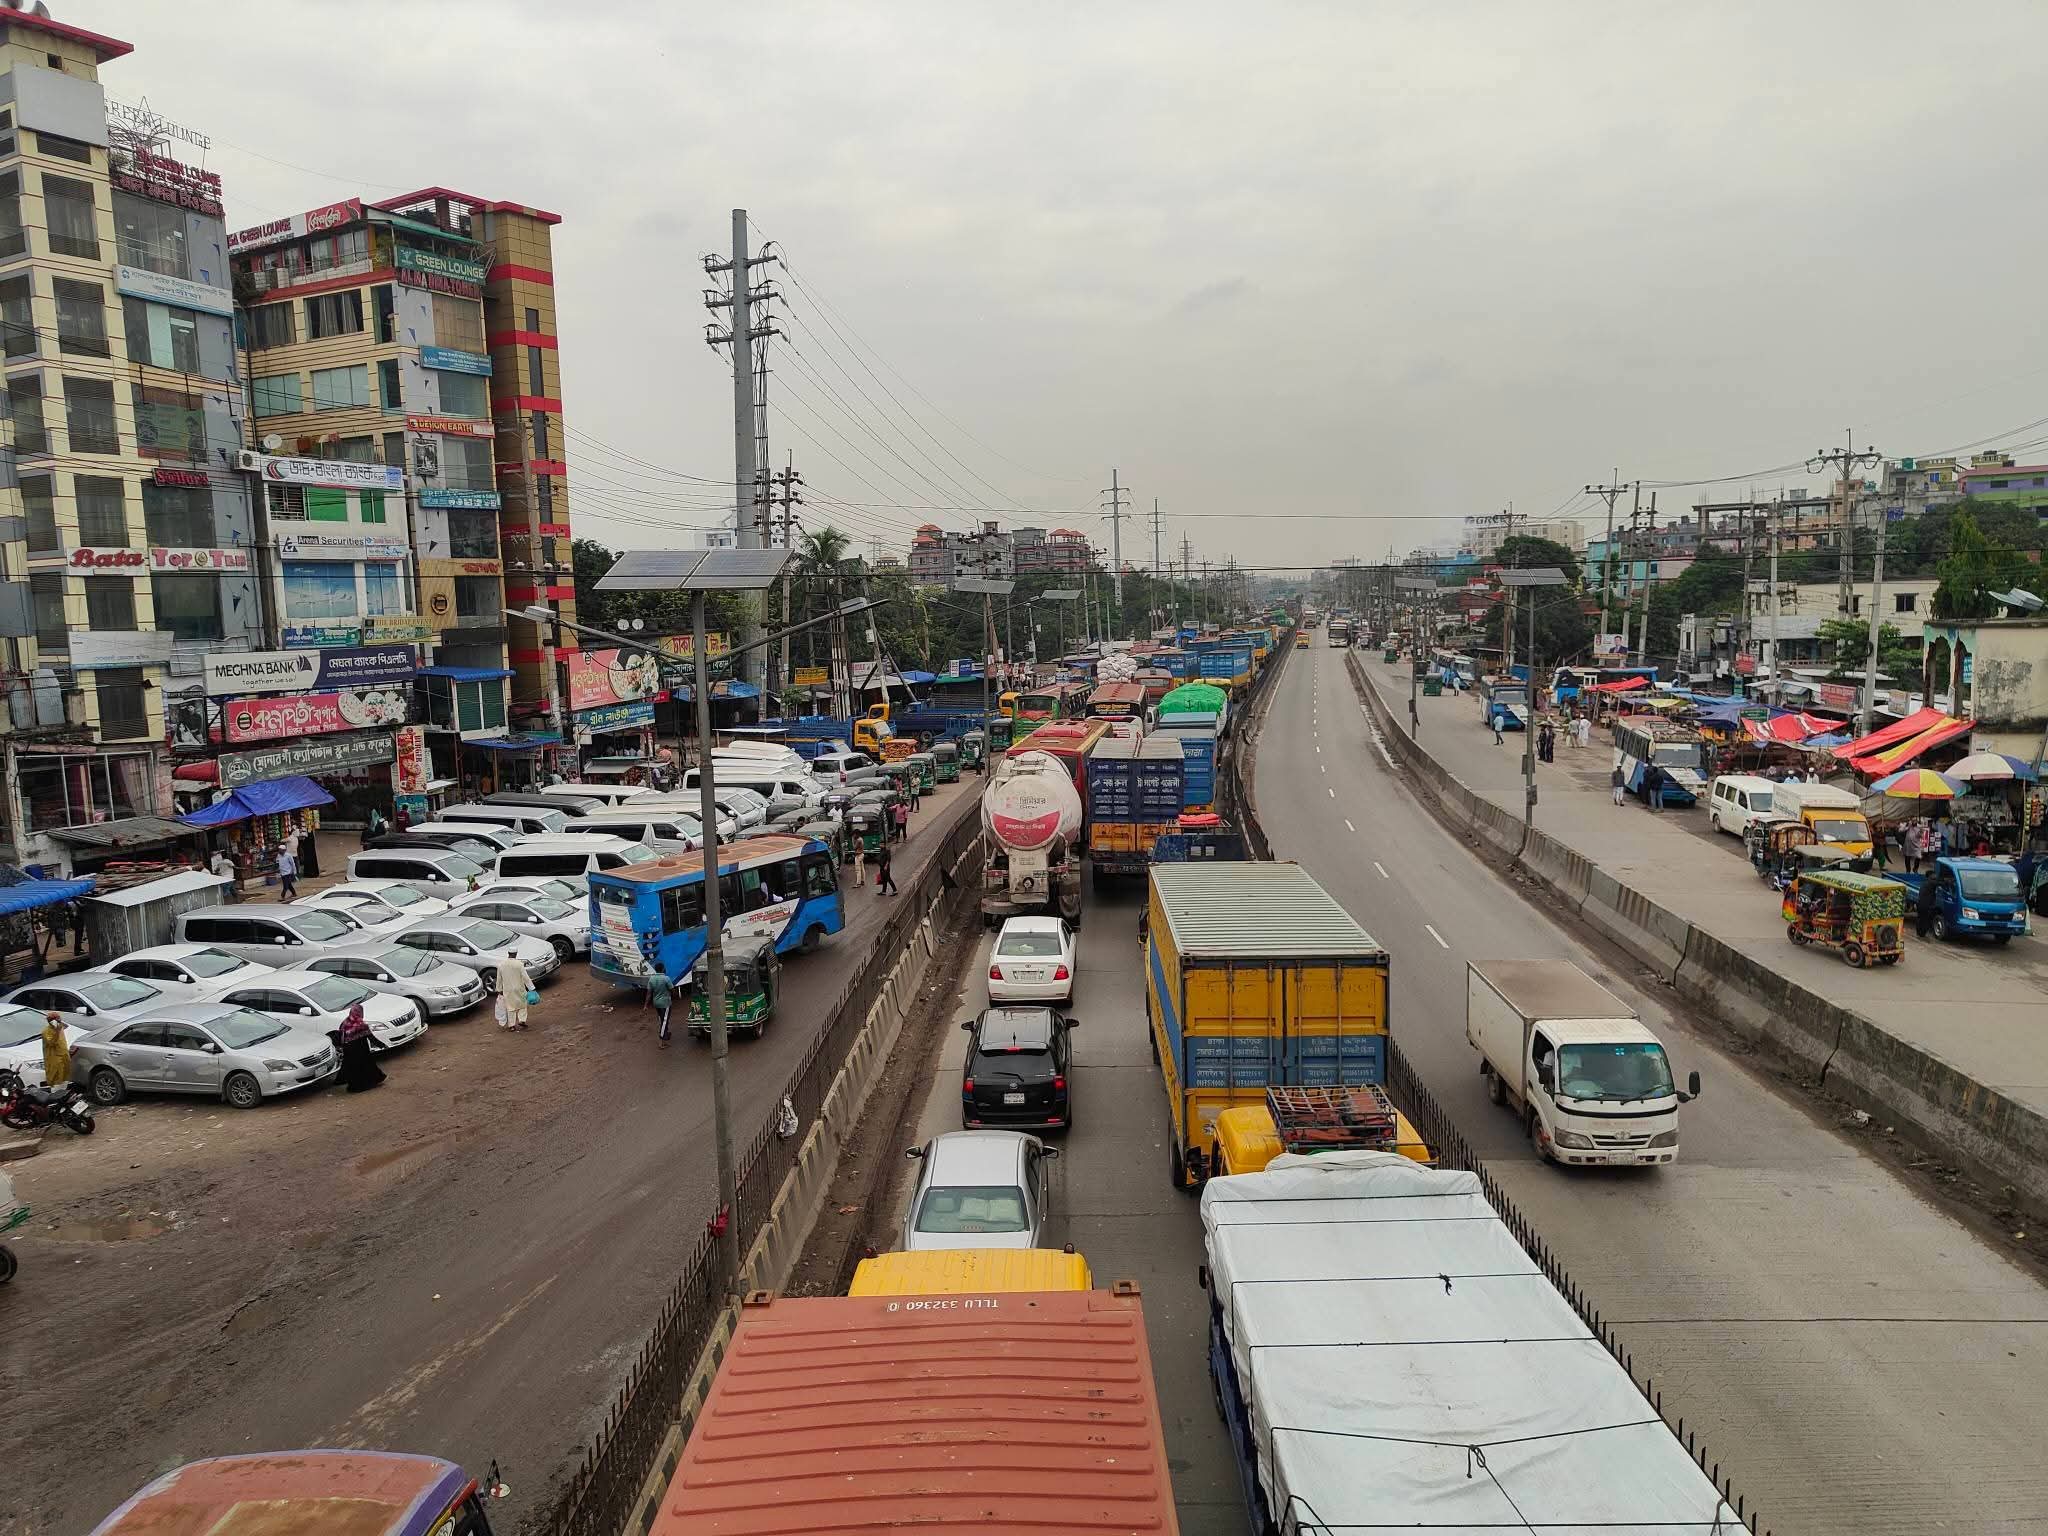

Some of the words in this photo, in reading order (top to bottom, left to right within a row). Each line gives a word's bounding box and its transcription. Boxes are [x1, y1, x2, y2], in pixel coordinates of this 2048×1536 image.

[415, 254, 447, 272] GREEN
[448, 261, 484, 278] LOUNGE
[448, 423, 472, 433] EARTH
[321, 537, 364, 546] Securities
[70, 549, 145, 568] Bata
[327, 656, 352, 669] মেঘনা
[354, 655, 376, 667] ব্যাংক
[215, 663, 267, 677] MEGHNA
[266, 661, 295, 675] BANK
[242, 679, 275, 689] together
[253, 749, 292, 773] সোনারগাঁ
[293, 743, 333, 763] ক্যাপিটাল
[334, 744, 350, 760] স্কুল
[367, 737, 393, 754] কলেজ
[906, 1300, 959, 1311] 332360
[964, 1299, 999, 1309] TLLU
